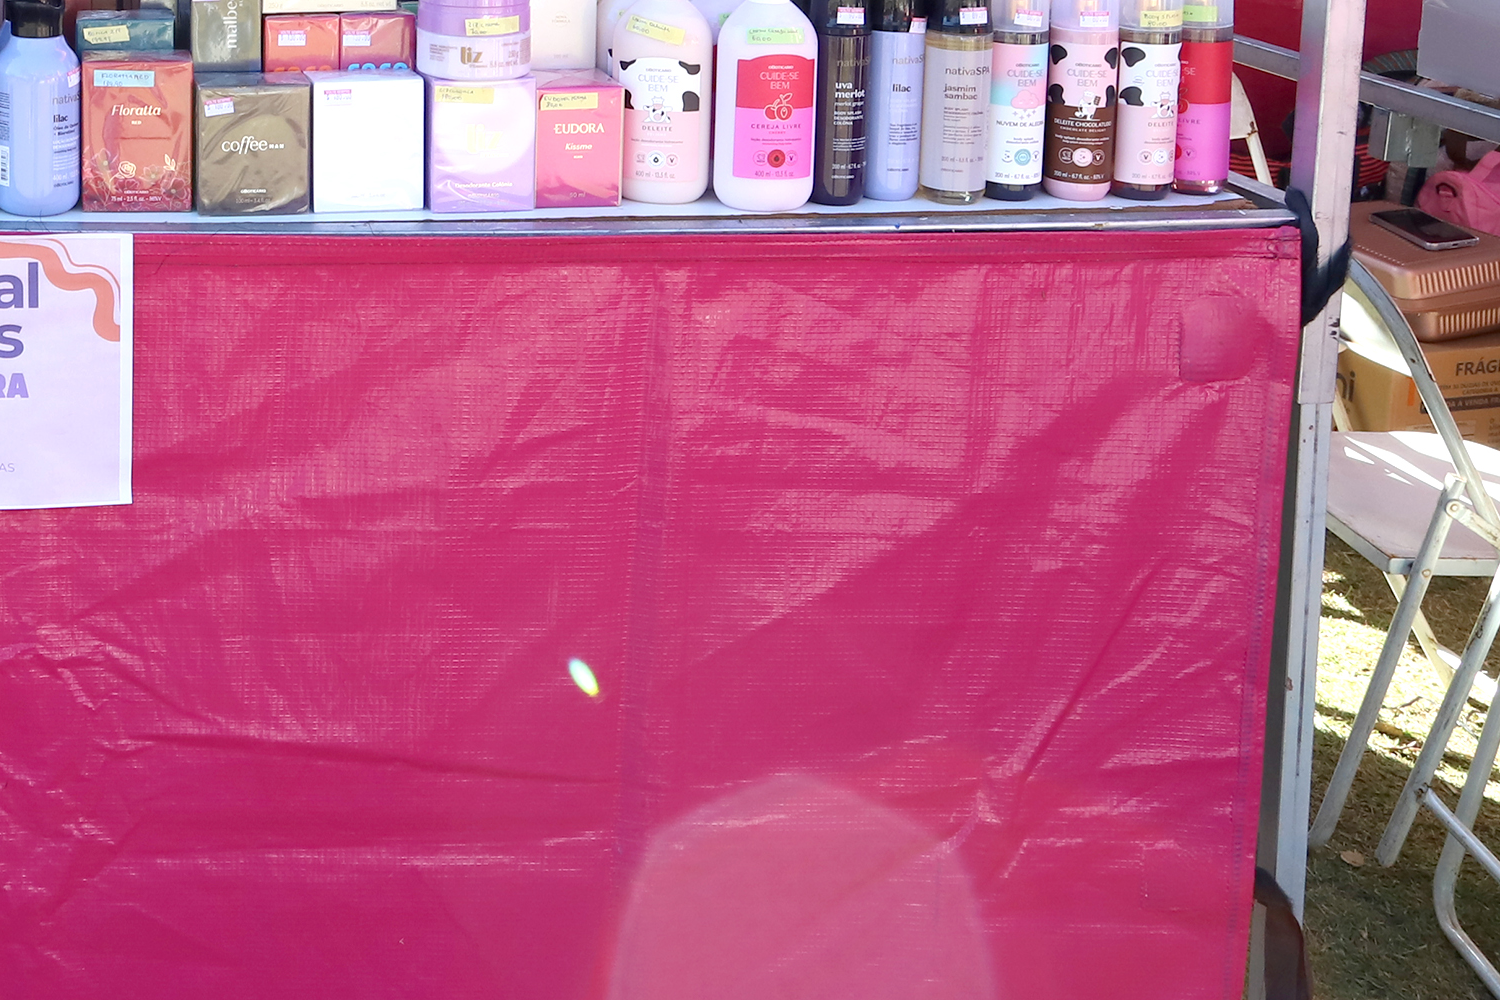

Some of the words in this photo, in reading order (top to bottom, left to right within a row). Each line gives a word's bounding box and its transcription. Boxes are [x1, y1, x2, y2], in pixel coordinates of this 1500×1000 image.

[945, 66, 990, 76] nativaSPA
[1007, 69, 1044, 78] CUIDE-SE
[1066, 68, 1108, 78] CUIDE-SE
[638, 73, 679, 84] CUIDE-SE
[760, 72, 800, 81] CUIDE-SE
[770, 81, 790, 90] BEM
[835, 82, 853, 90] uva
[1017, 79, 1037, 87] BEM
[1077, 79, 1098, 87] BEM
[648, 83, 669, 93] BEM
[892, 83, 912, 93] lilac
[943, 83, 977, 93] jasmim
[835, 90, 866, 99] merlot
[111, 104, 161, 116] Floratta
[53, 114, 68, 123] lilac
[1054, 118, 1074, 126] DELEITE
[553, 123, 605, 134] EUDORA
[221, 136, 268, 155] coffee
[565, 143, 592, 151] Kissme
[1455, 357, 1500, 377] FRÁG
